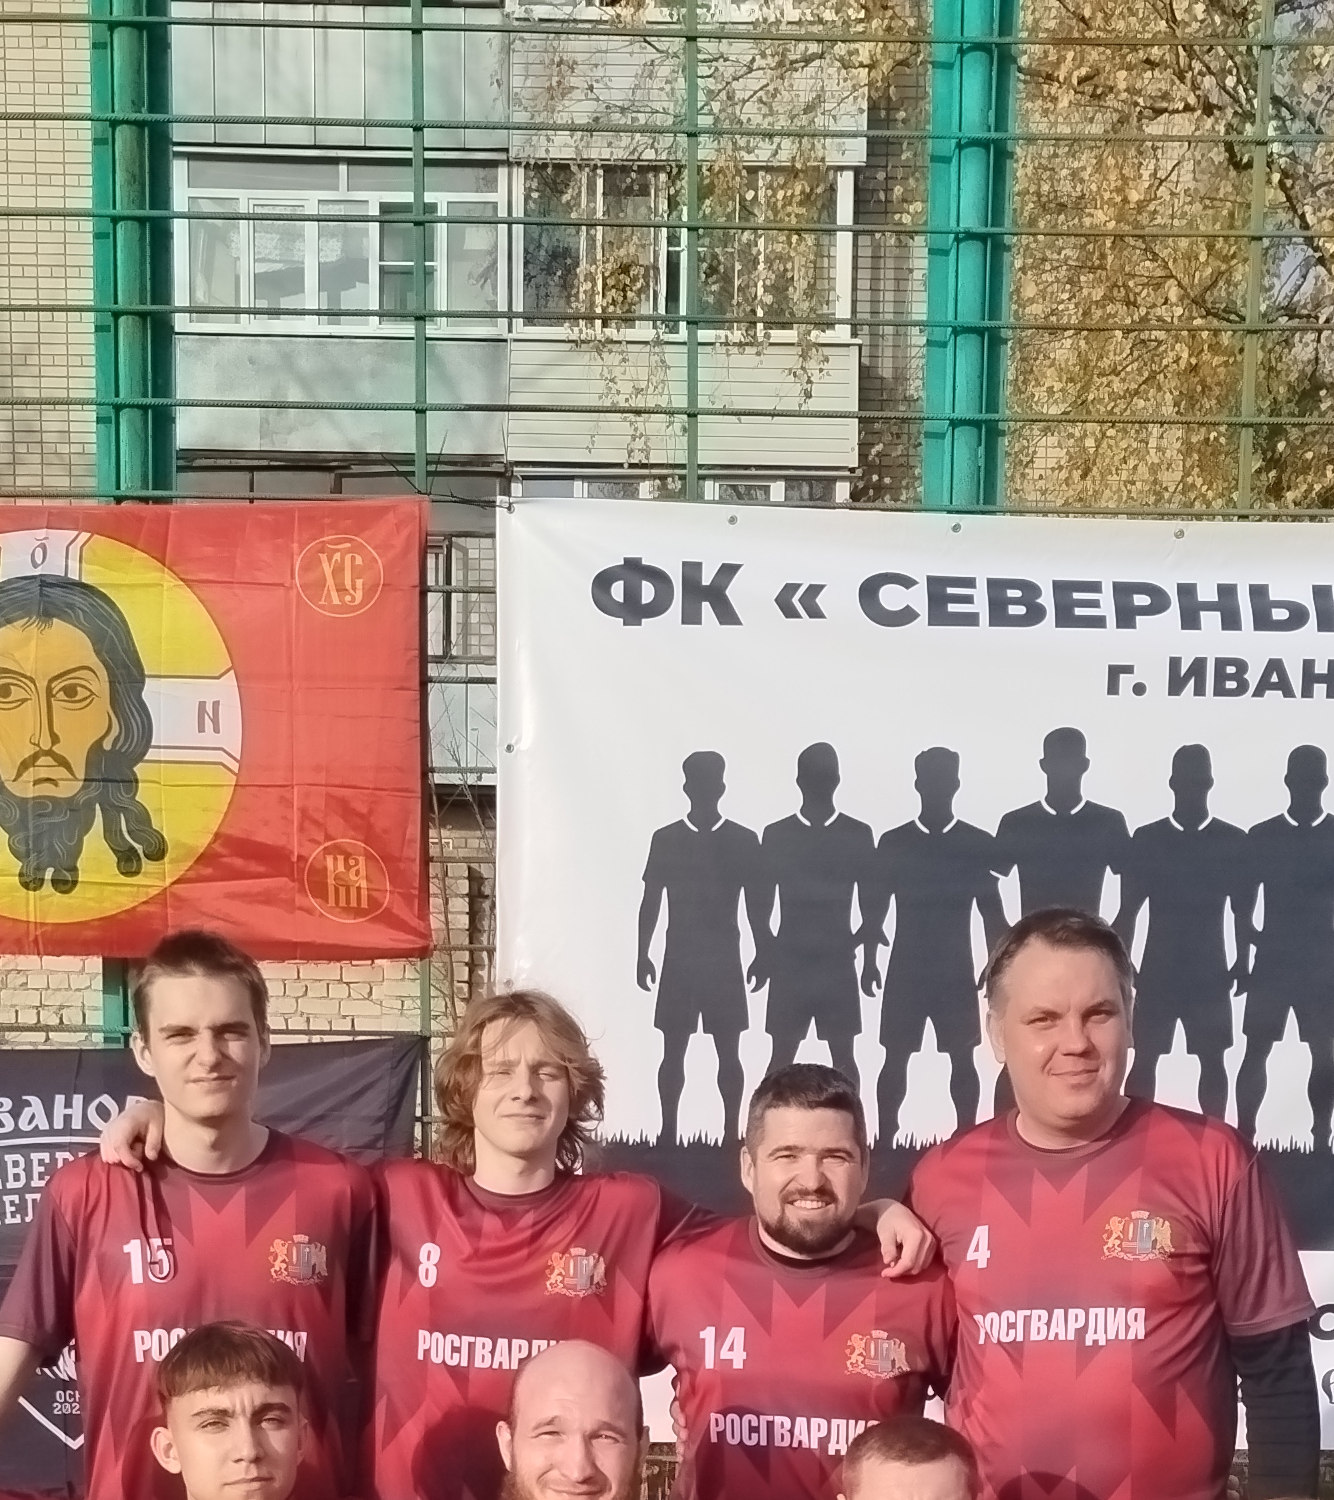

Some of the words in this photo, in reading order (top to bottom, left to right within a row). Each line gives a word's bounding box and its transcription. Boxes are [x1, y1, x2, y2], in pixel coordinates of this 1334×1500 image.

[590, 557, 744, 626] ФК
[1106, 663, 1147, 697] г.
[123, 1238, 175, 1284] 15
[418, 1243, 441, 1288] 8
[967, 1225, 990, 1268] 4
[699, 1326, 747, 1369] 14
